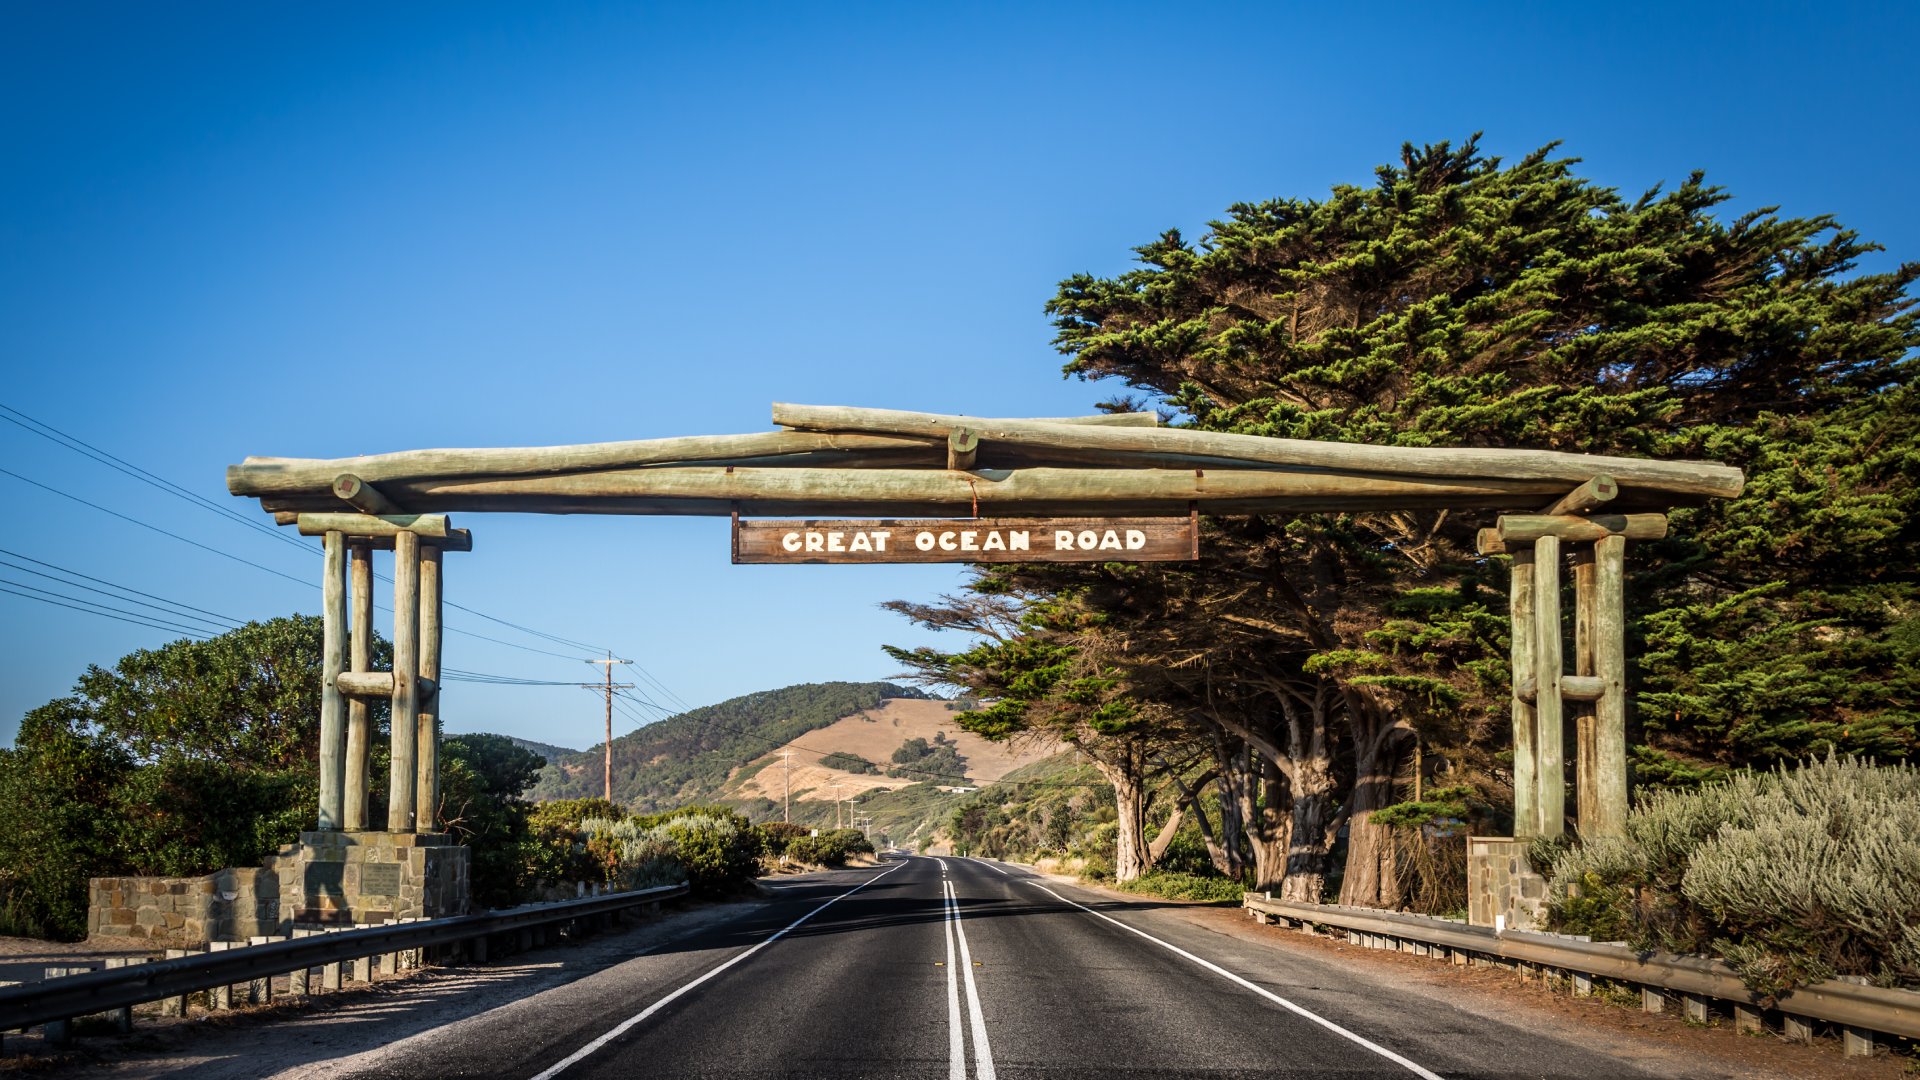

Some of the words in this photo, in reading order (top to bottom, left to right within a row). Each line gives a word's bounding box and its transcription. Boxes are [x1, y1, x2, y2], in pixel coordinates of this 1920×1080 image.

[781, 531, 891, 553] GREAT
[914, 530, 1030, 552] OCEAN
[1054, 529, 1147, 551] ROAD
